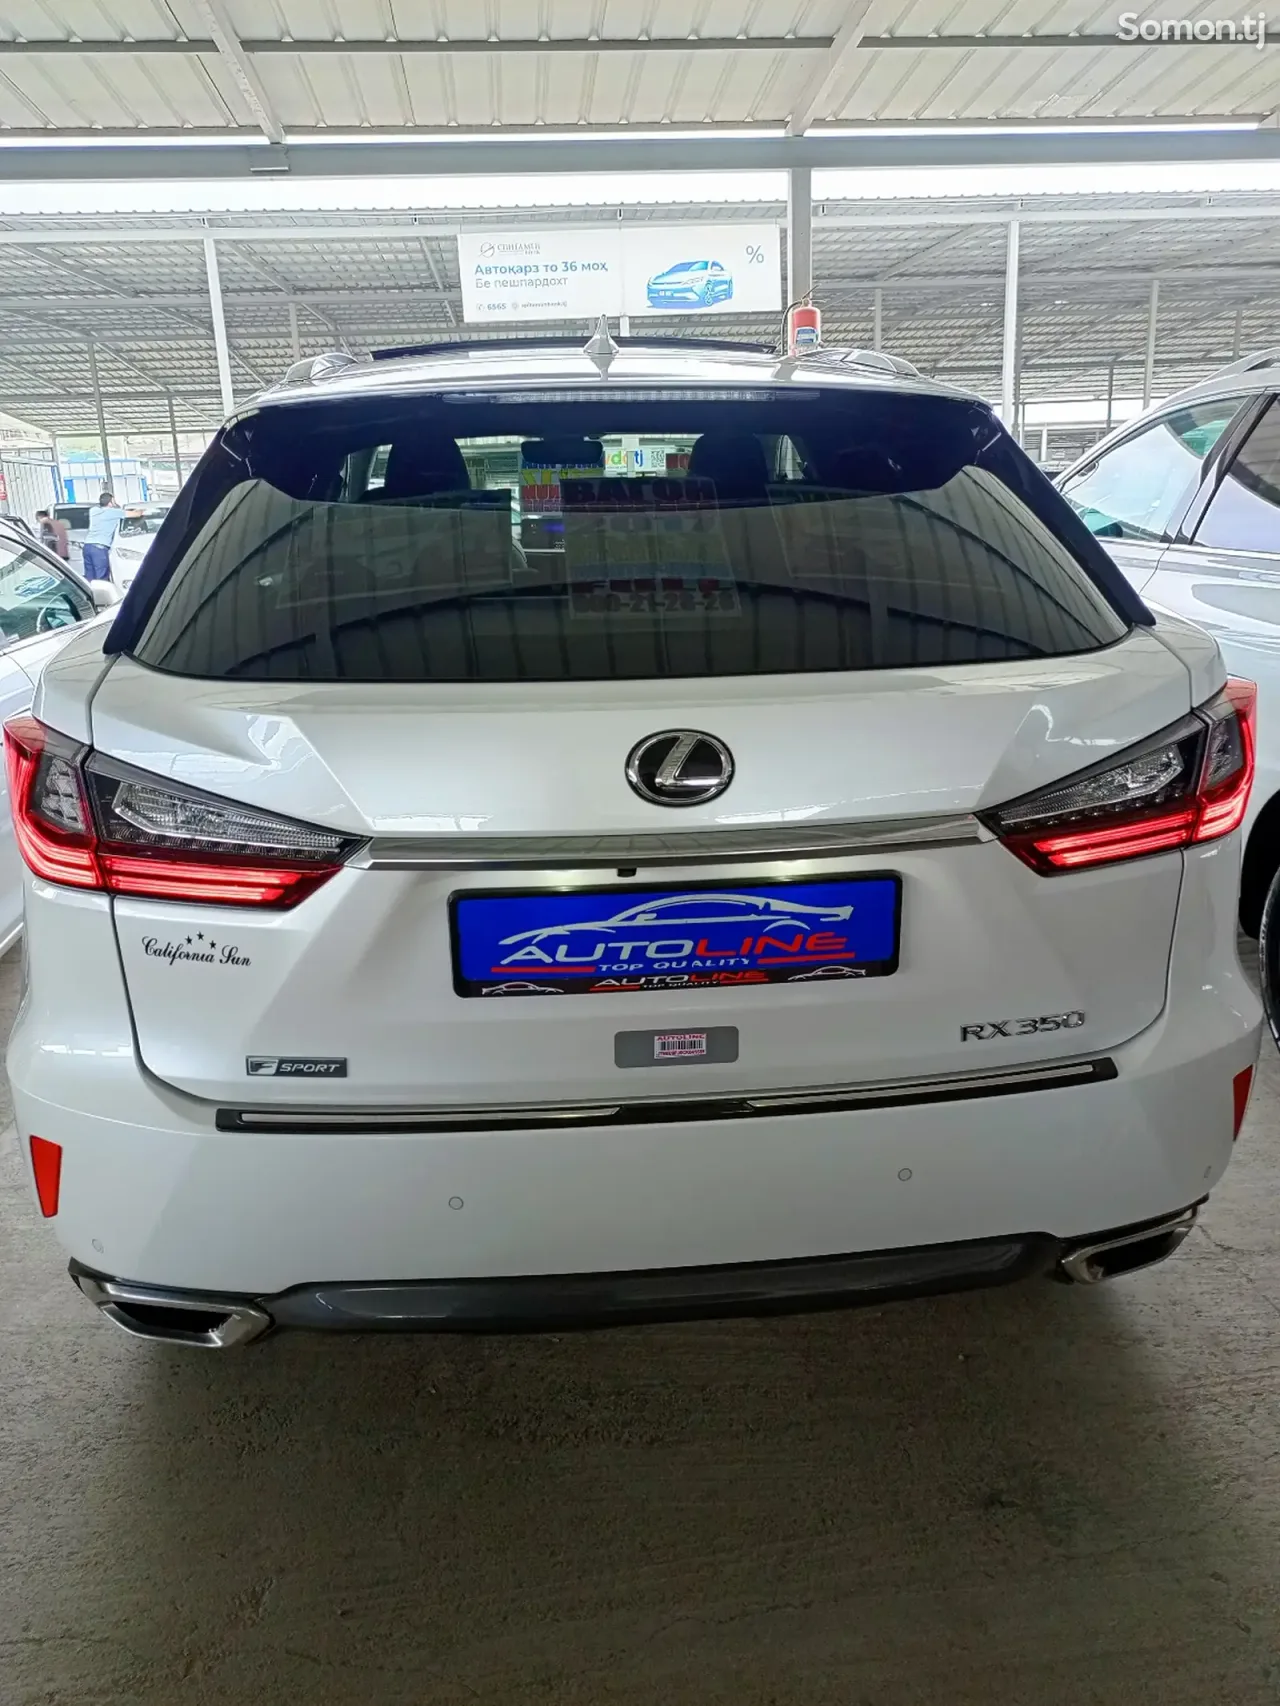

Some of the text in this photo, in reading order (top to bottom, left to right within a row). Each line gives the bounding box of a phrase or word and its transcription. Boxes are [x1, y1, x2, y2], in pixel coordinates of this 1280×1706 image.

[474, 264, 540, 277] Автоқарз
[543, 263, 559, 273] то
[561, 260, 578, 272] 36
[475, 276, 569, 289] Бе пешпардохт
[487, 302, 507, 311] 6565
[141, 935, 252, 967] California Sun
[500, 931, 848, 966] AUTOLINE
[598, 957, 751, 972] TOP QUALITY
[595, 970, 766, 987] AUTOLINE
[960, 1009, 1086, 1042] RX 350
[279, 1062, 341, 1073] SPORT
